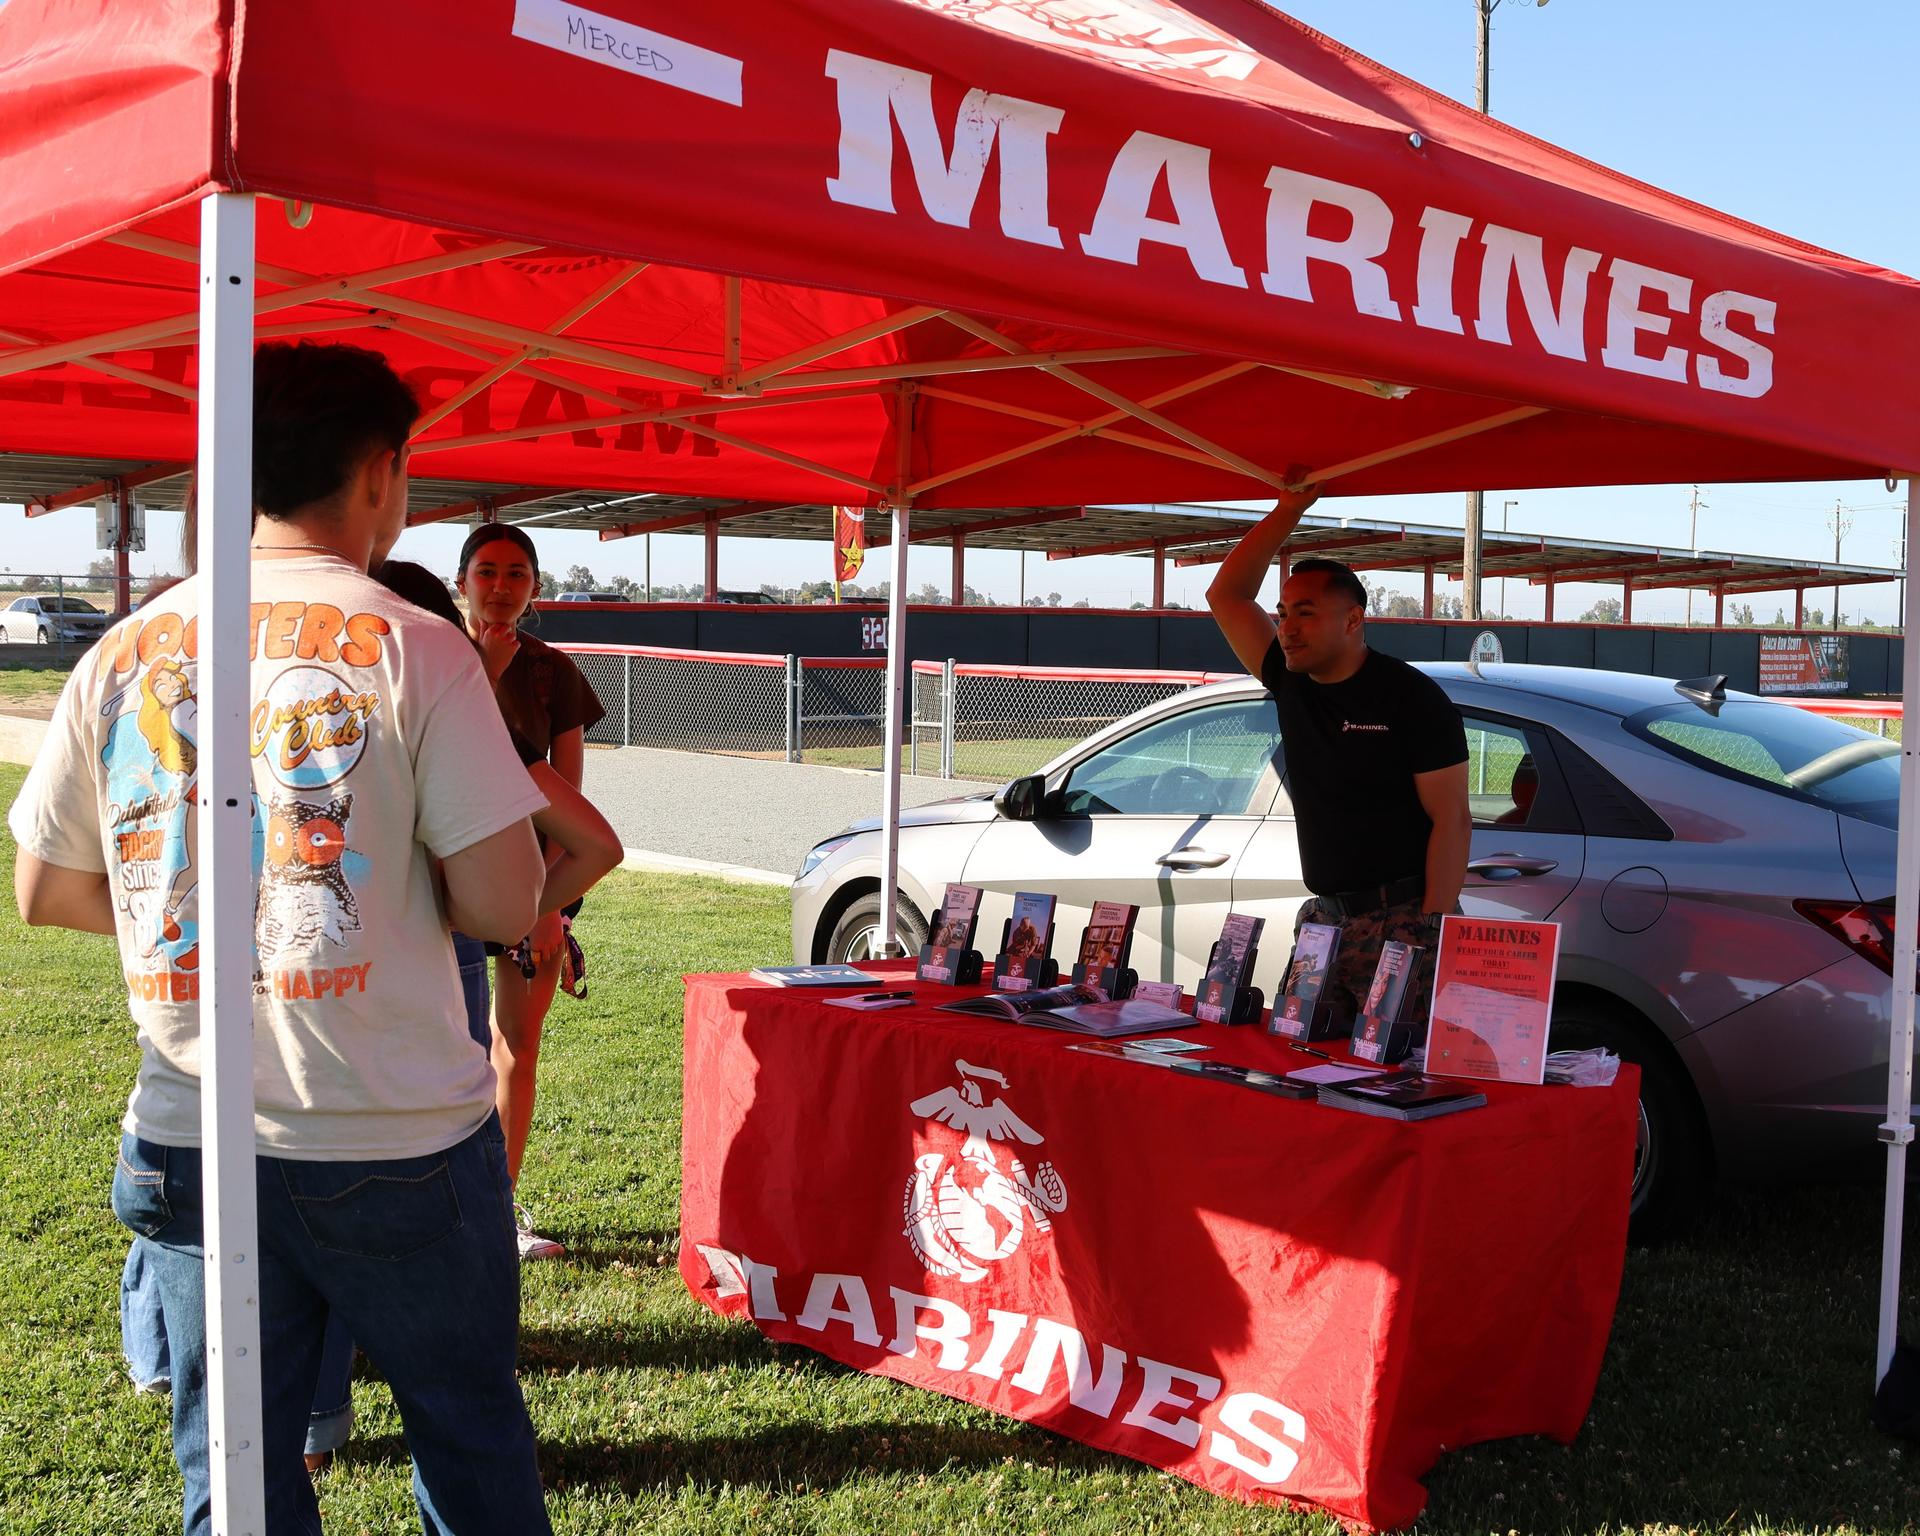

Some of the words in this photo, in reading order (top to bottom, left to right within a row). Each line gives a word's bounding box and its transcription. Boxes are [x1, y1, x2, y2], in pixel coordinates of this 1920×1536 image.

[567, 14, 673, 72] MERCED
[825, 48, 1777, 398] MARINES
[862, 616, 888, 650] 32
[250, 687, 378, 757] Country
[280, 714, 362, 770] Club
[1456, 946, 1481, 955] START
[1484, 948, 1504, 956] YOUR
[1506, 950, 1537, 959] CAREER
[1458, 925, 1541, 945] MARINES
[273, 962, 372, 1000] HAPPY
[695, 1243, 1306, 1484] MARINES
